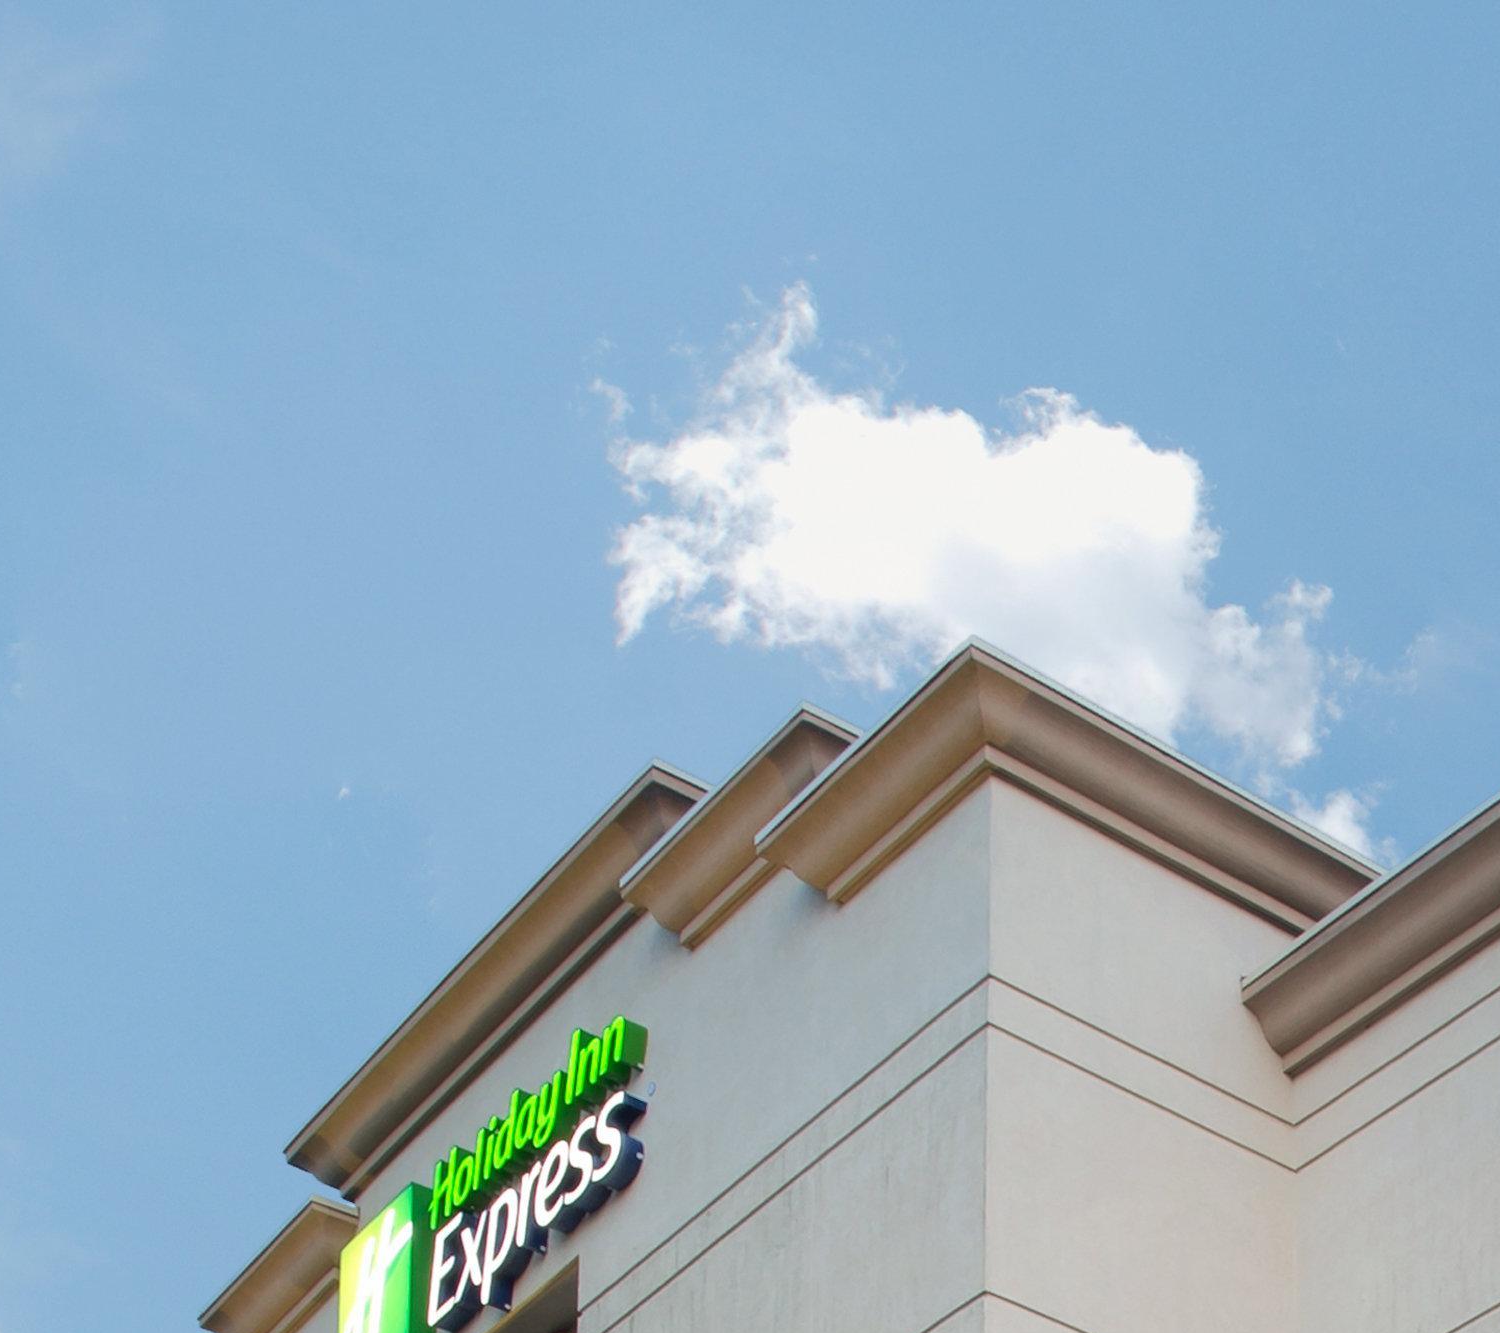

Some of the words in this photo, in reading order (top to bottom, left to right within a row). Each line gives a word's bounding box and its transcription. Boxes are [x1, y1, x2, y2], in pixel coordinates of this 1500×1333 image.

[427, 1090, 627, 1328] Express
[428, 1070, 565, 1230] Holiday
[564, 1015, 628, 1105] Inn
